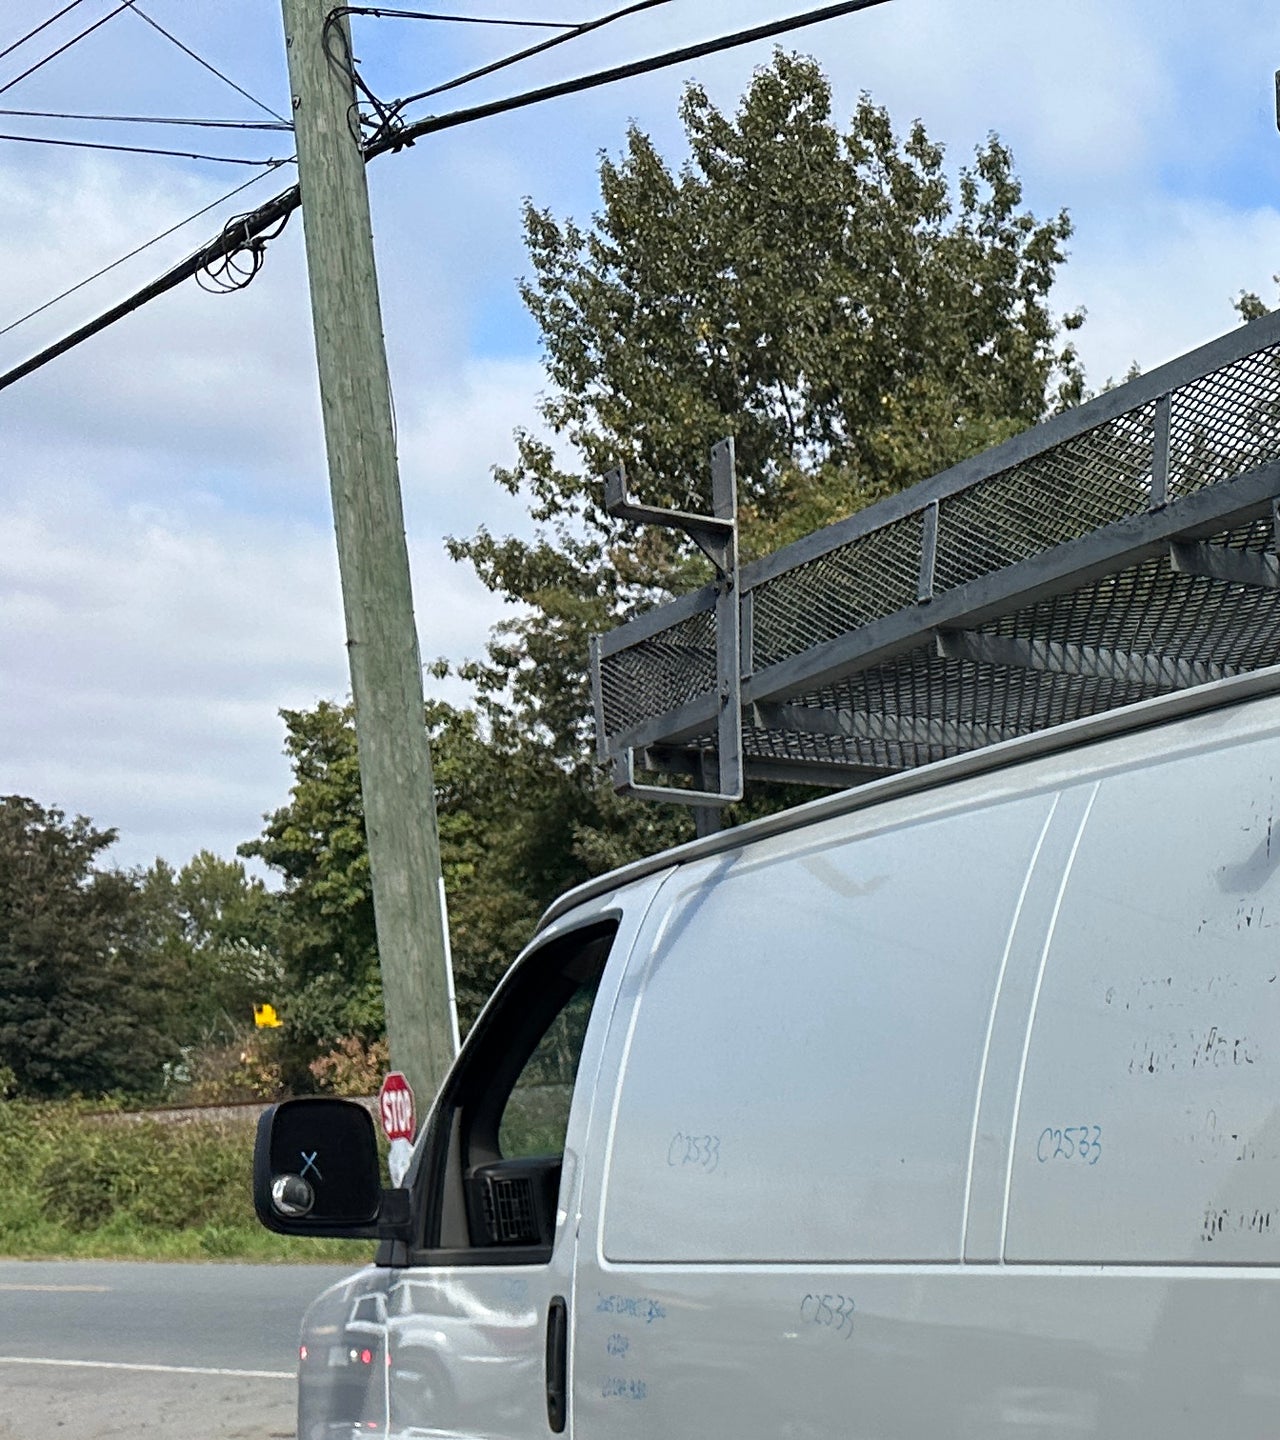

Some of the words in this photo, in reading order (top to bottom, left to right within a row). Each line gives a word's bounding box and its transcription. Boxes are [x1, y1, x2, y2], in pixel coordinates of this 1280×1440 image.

[382, 1089, 412, 1133] STOP
[667, 1132, 720, 1173] C2533
[1036, 1124, 1104, 1166] C2533
[801, 1293, 855, 1340] C2533
